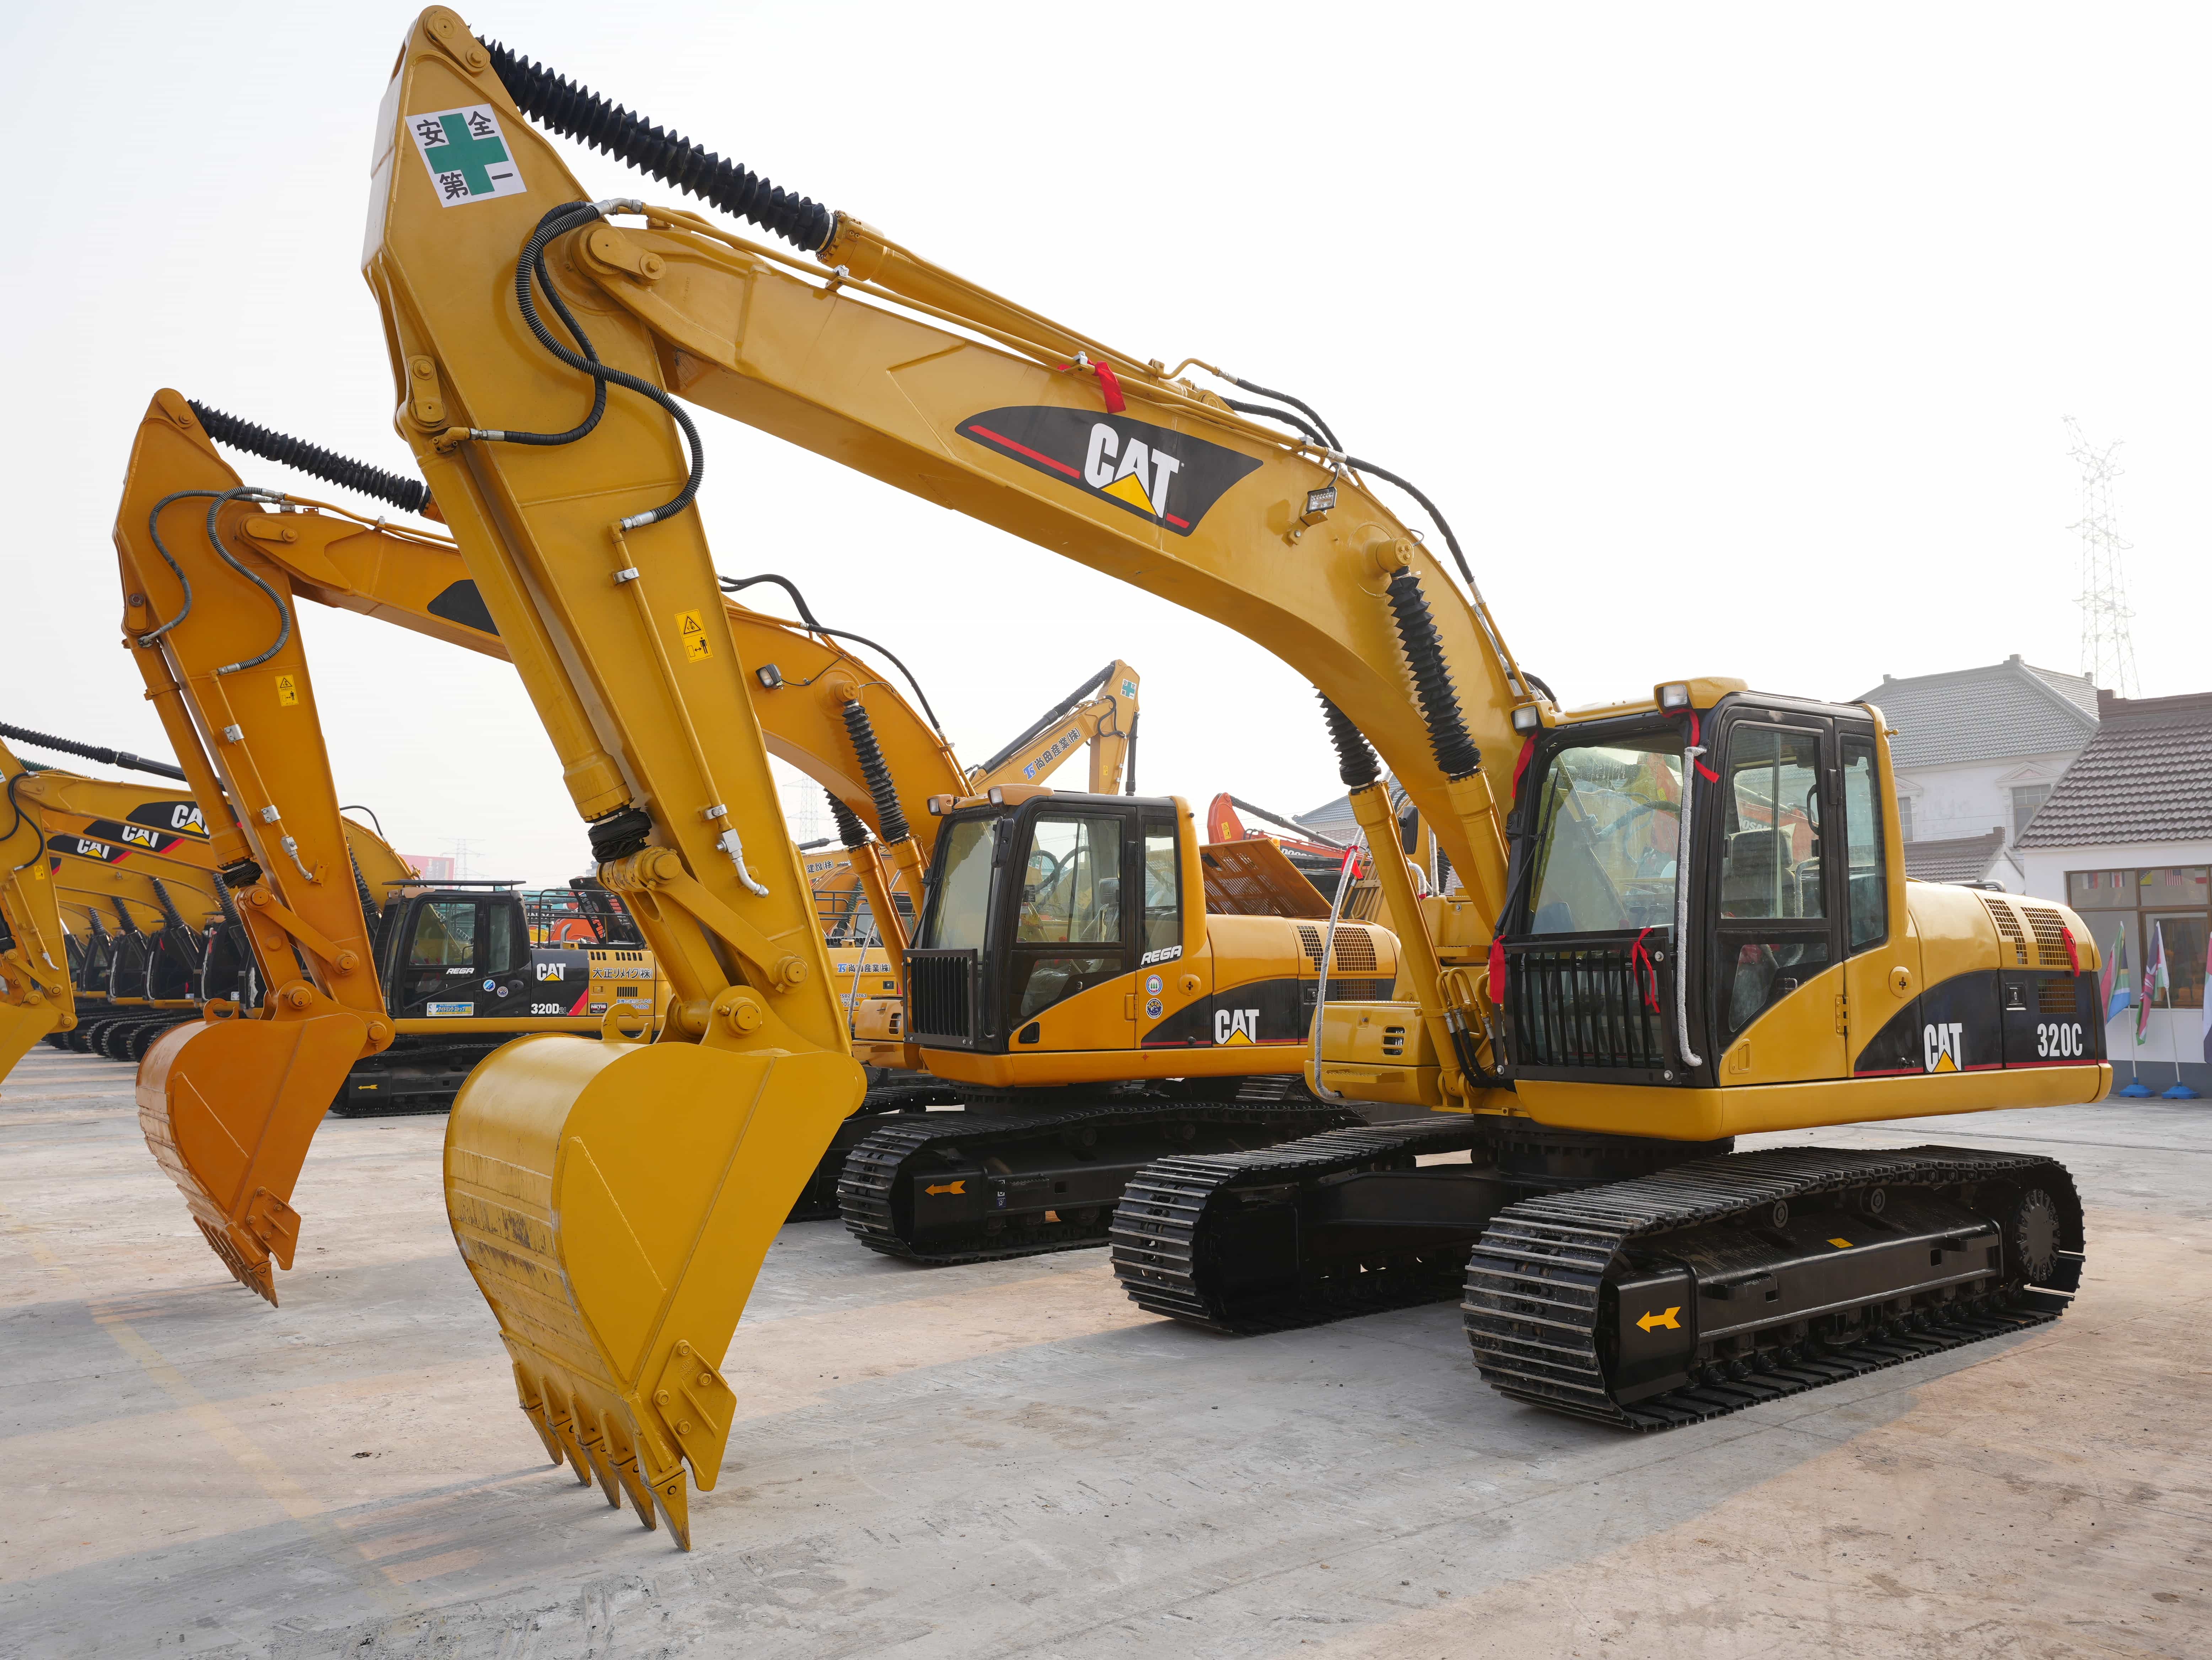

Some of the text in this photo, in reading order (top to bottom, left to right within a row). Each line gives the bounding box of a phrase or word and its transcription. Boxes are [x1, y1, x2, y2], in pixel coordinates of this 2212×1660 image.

[1084, 423, 1180, 518] CAT
[171, 805, 209, 835] CA
[1141, 945, 1182, 965] REGA
[536, 963, 566, 981] CAT
[592, 968, 653, 979] 大正リメイク(株)
[1215, 1009, 1259, 1044] CAT
[2037, 1023, 2083, 1057] 320C
[1924, 1023, 1962, 1073] CAT
